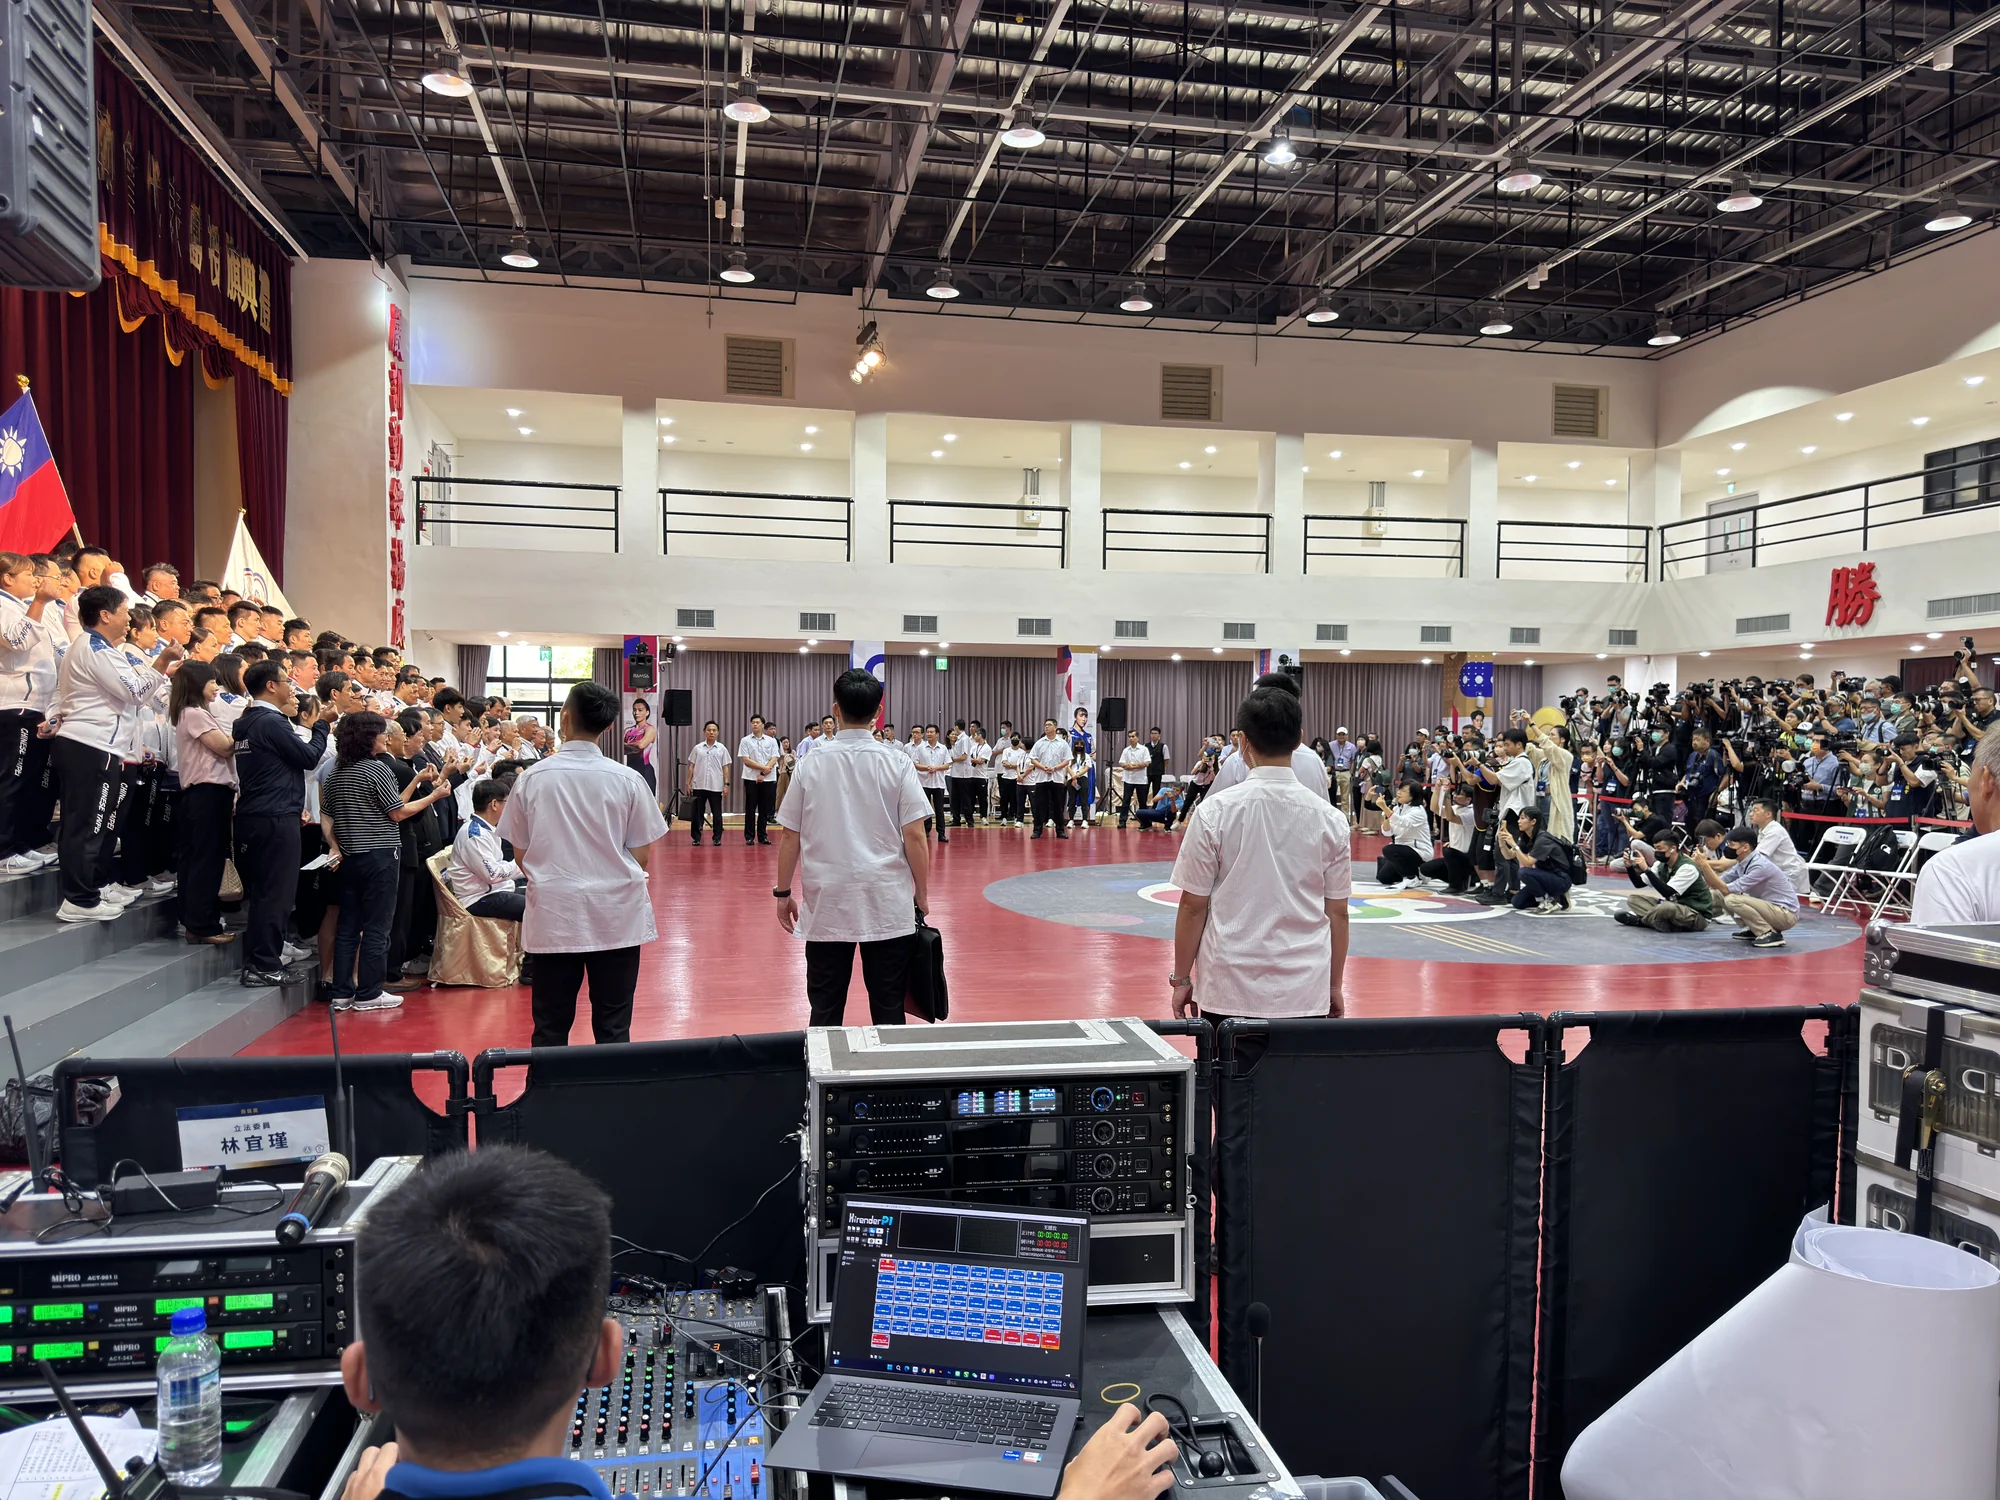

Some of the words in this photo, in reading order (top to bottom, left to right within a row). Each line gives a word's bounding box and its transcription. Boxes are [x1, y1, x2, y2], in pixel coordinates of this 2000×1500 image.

[1825, 562, 1881, 627] 勝
[20, 727, 29, 755] CHINESE
[14, 757, 24, 777] TAIPEI
[98, 782, 110, 812] CHINESE
[94, 813, 104, 834] TAIPEI
[106, 810, 118, 831] TAIPEI
[234, 1122, 270, 1132] 立法委員
[221, 1131, 289, 1155] 林宜瑾
[51, 1272, 81, 1282] MIPRO
[114, 1304, 138, 1312] MIPRO
[733, 1320, 757, 1328] YAMAHA
[113, 1342, 140, 1352] MIPRO
